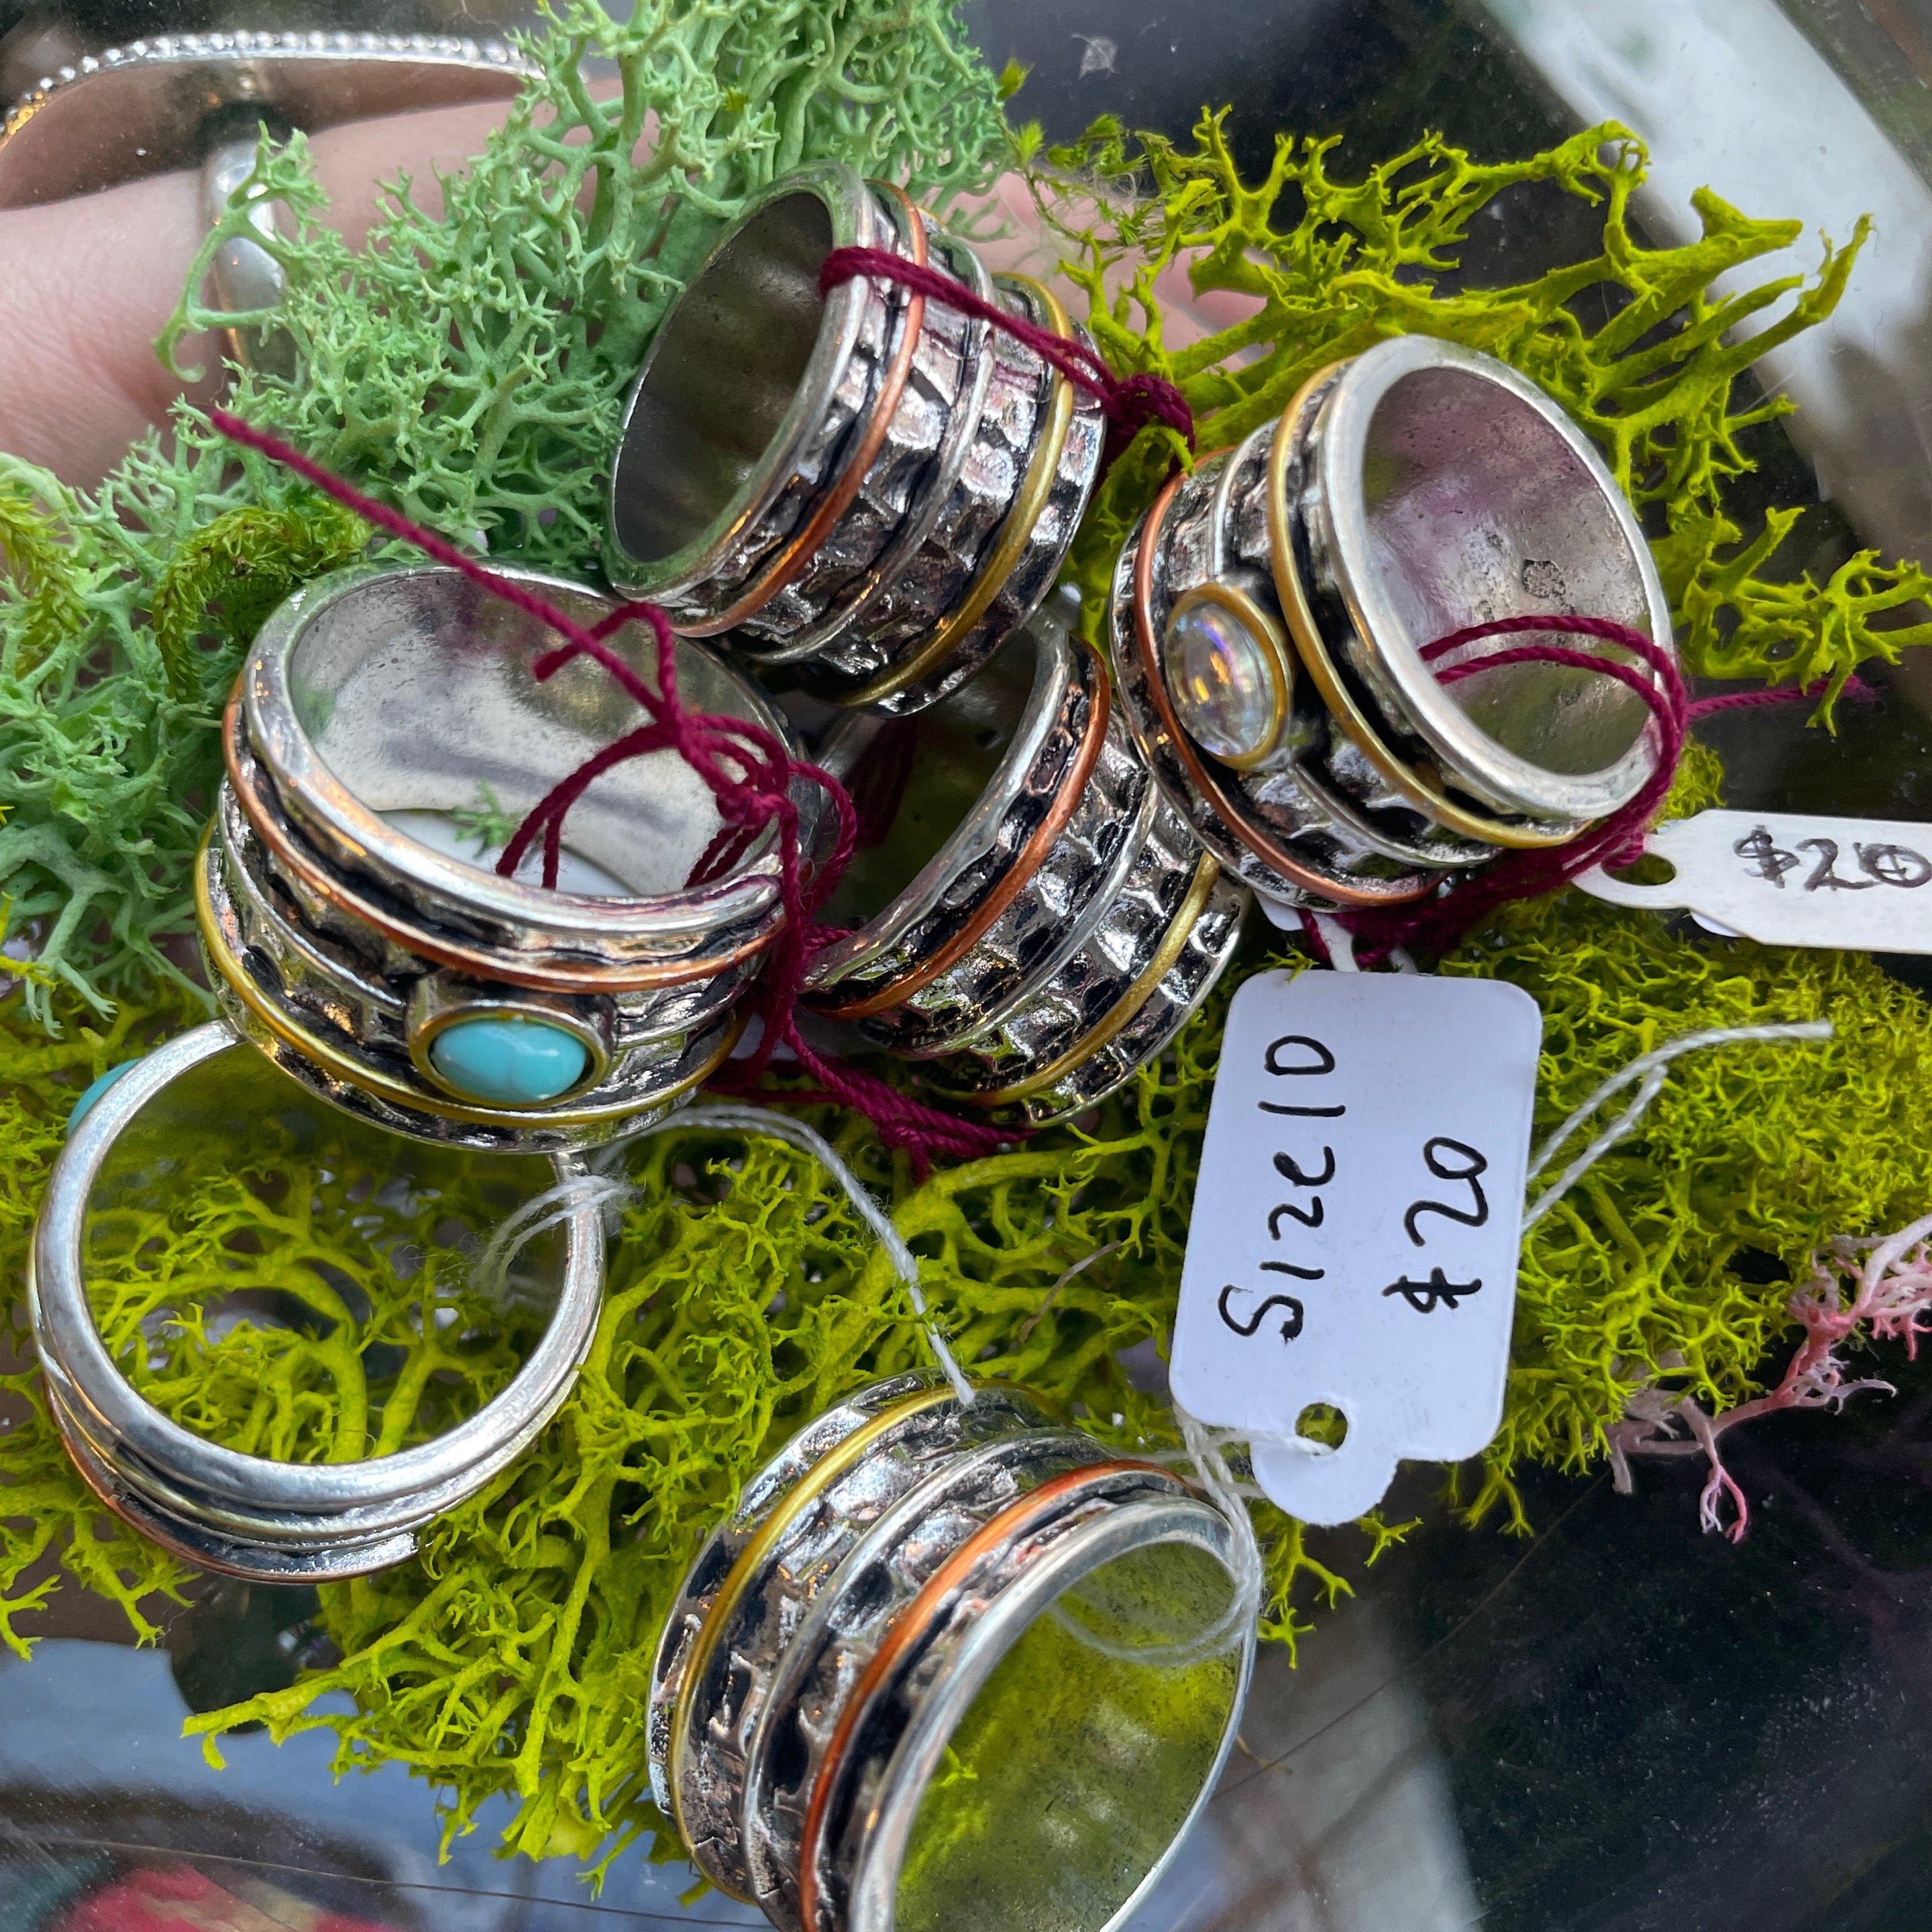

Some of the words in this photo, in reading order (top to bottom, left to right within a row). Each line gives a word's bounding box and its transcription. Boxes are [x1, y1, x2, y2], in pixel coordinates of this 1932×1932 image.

[1733, 824, 1932, 892] $20
[1257, 1034, 1346, 1118] 10
[1218, 1145, 1336, 1345] Size
[1382, 1136, 1489, 1314] $20
